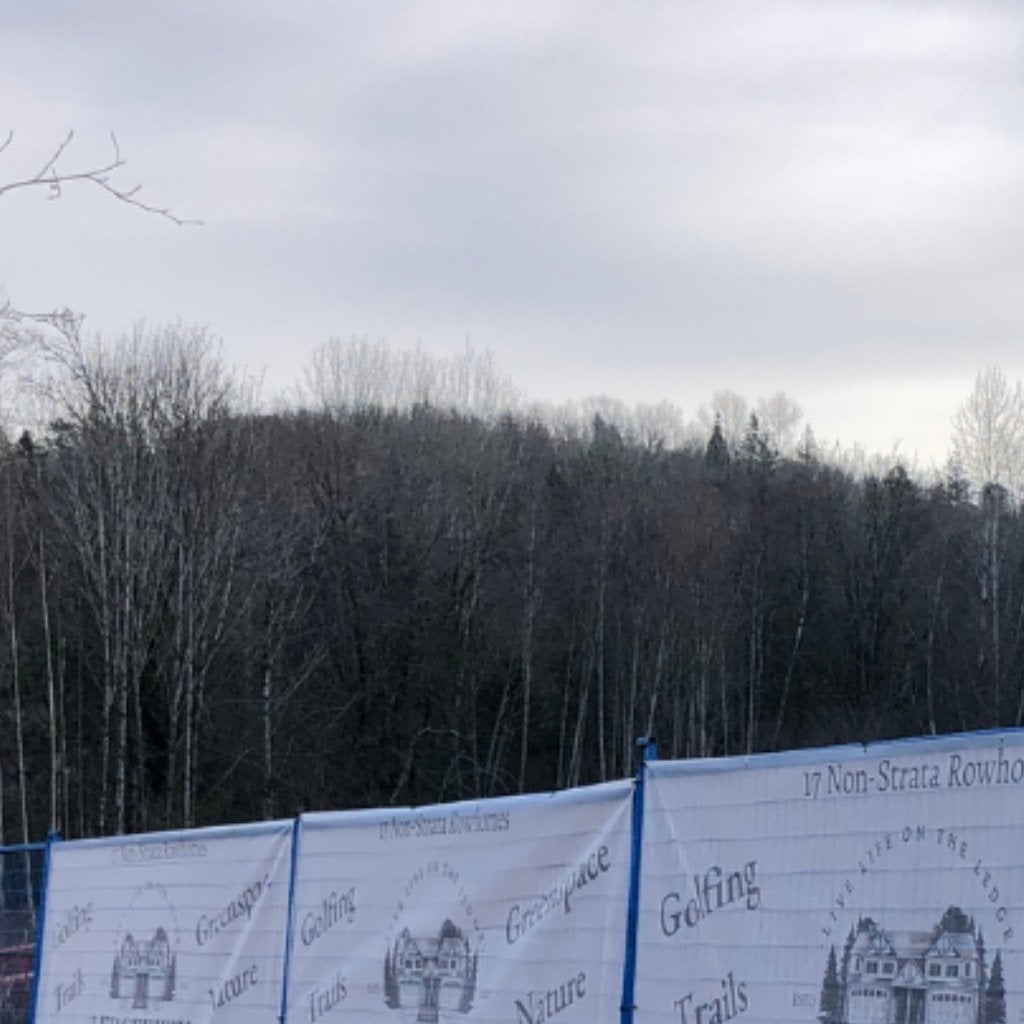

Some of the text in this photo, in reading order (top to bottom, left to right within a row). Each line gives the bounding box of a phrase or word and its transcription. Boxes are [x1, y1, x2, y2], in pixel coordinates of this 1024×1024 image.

[803, 772, 822, 799] 17
[827, 759, 941, 795] Non-Strata
[661, 861, 761, 937] Golfing
